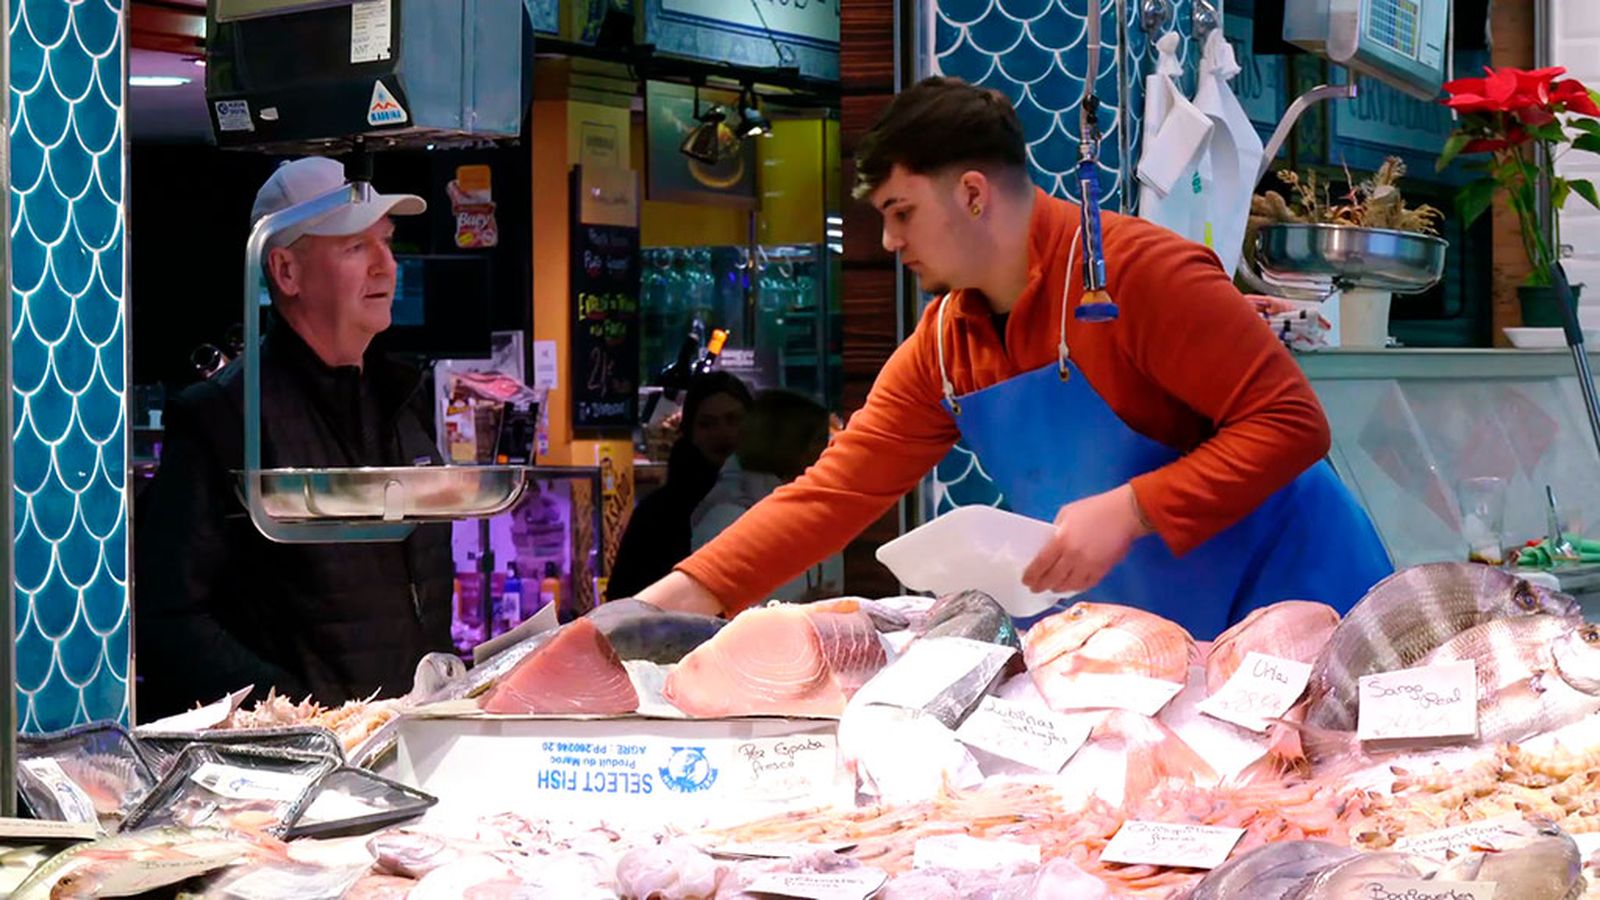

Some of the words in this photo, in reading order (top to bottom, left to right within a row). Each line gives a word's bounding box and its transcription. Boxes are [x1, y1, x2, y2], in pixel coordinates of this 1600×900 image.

[549, 756, 581, 767] Maroc
[583, 758, 597, 767] du
[599, 758, 636, 770] Produit
[537, 769, 577, 791] FISH
[582, 771, 653, 795] SELECT
